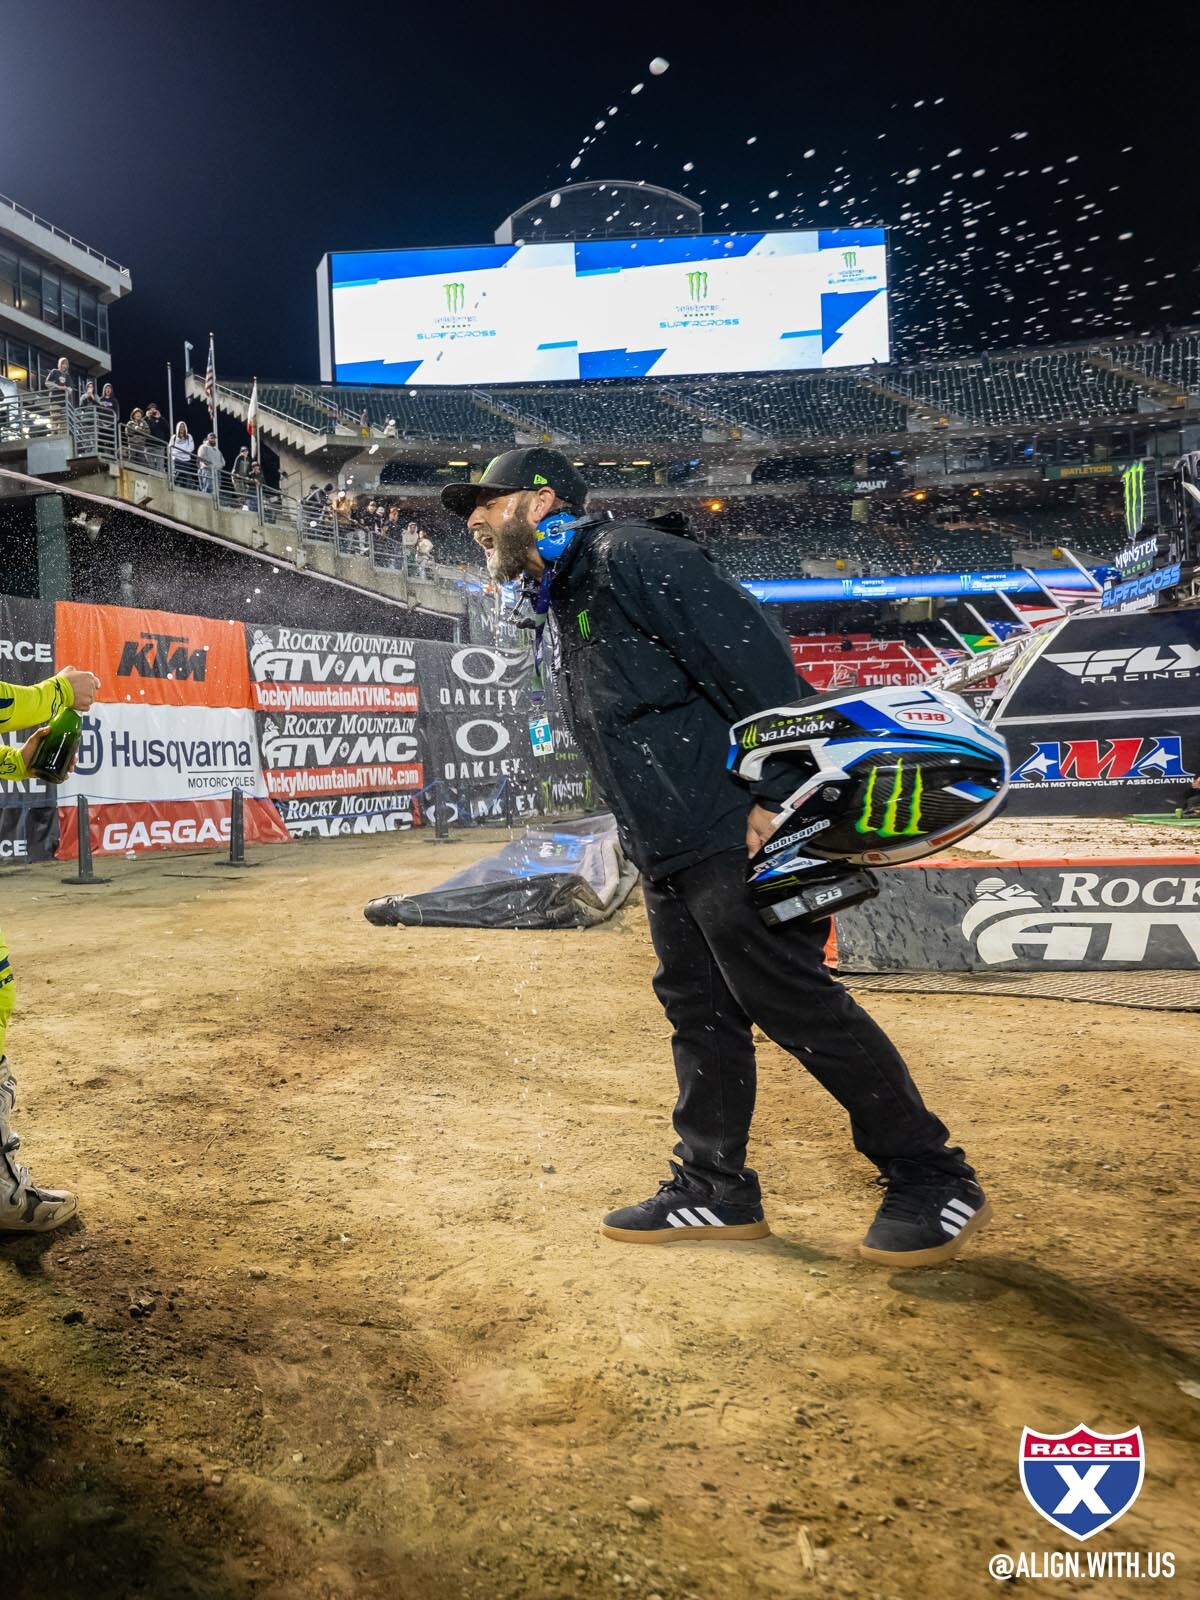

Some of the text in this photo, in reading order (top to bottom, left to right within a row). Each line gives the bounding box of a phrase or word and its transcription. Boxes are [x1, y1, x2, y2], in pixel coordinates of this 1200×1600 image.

[1115, 538, 1158, 569] MONSTER
[1102, 563, 1181, 609] SUPERCROSS
[277, 629, 415, 656] ROCKY MOUNTAIN
[117, 632, 207, 682] KTM
[1081, 671, 1191, 685] RACING
[440, 688, 520, 706] OAKLEY
[282, 714, 416, 735] ROCKY MOUNTAIN
[904, 711, 947, 722] BELL
[761, 720, 835, 742] MONSTER
[111, 730, 251, 774] Husqvarna
[1008, 736, 1196, 783] AMA
[445, 759, 521, 780] OAKLEY
[188, 776, 256, 788] MOTORCYCLES
[1007, 777, 1194, 790] MERICAN MOTORCYCLIST ASSOCIATION
[287, 795, 413, 820] ROCKY MOUNTAIN
[815, 886, 843, 905] ET3
